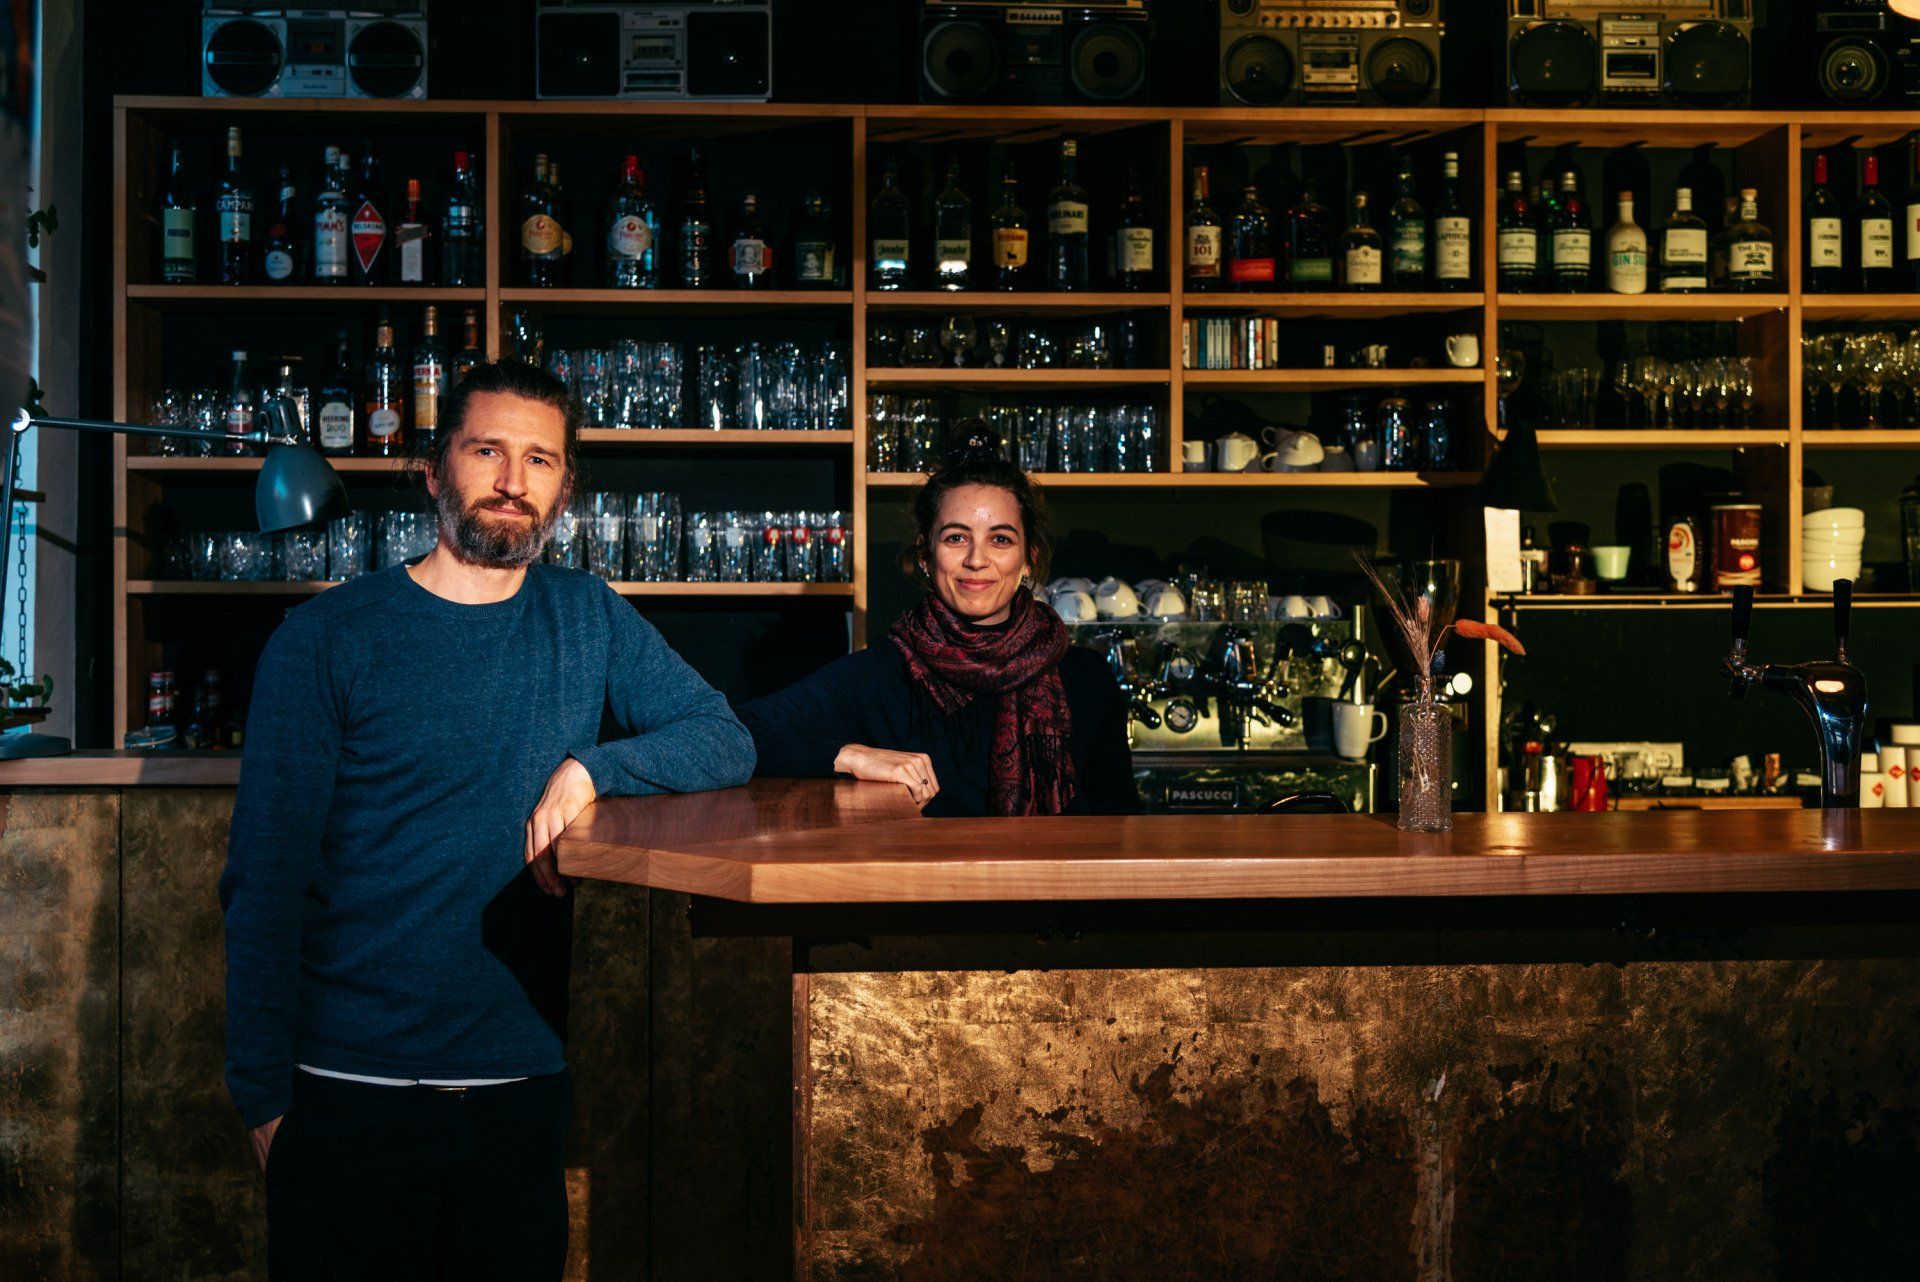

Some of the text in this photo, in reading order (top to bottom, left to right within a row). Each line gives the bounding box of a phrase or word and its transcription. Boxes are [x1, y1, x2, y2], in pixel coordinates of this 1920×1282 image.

[1194, 246, 1212, 255] 101
[1612, 255, 1631, 265] GIN
[1172, 790, 1232, 800] PASCUCCI
